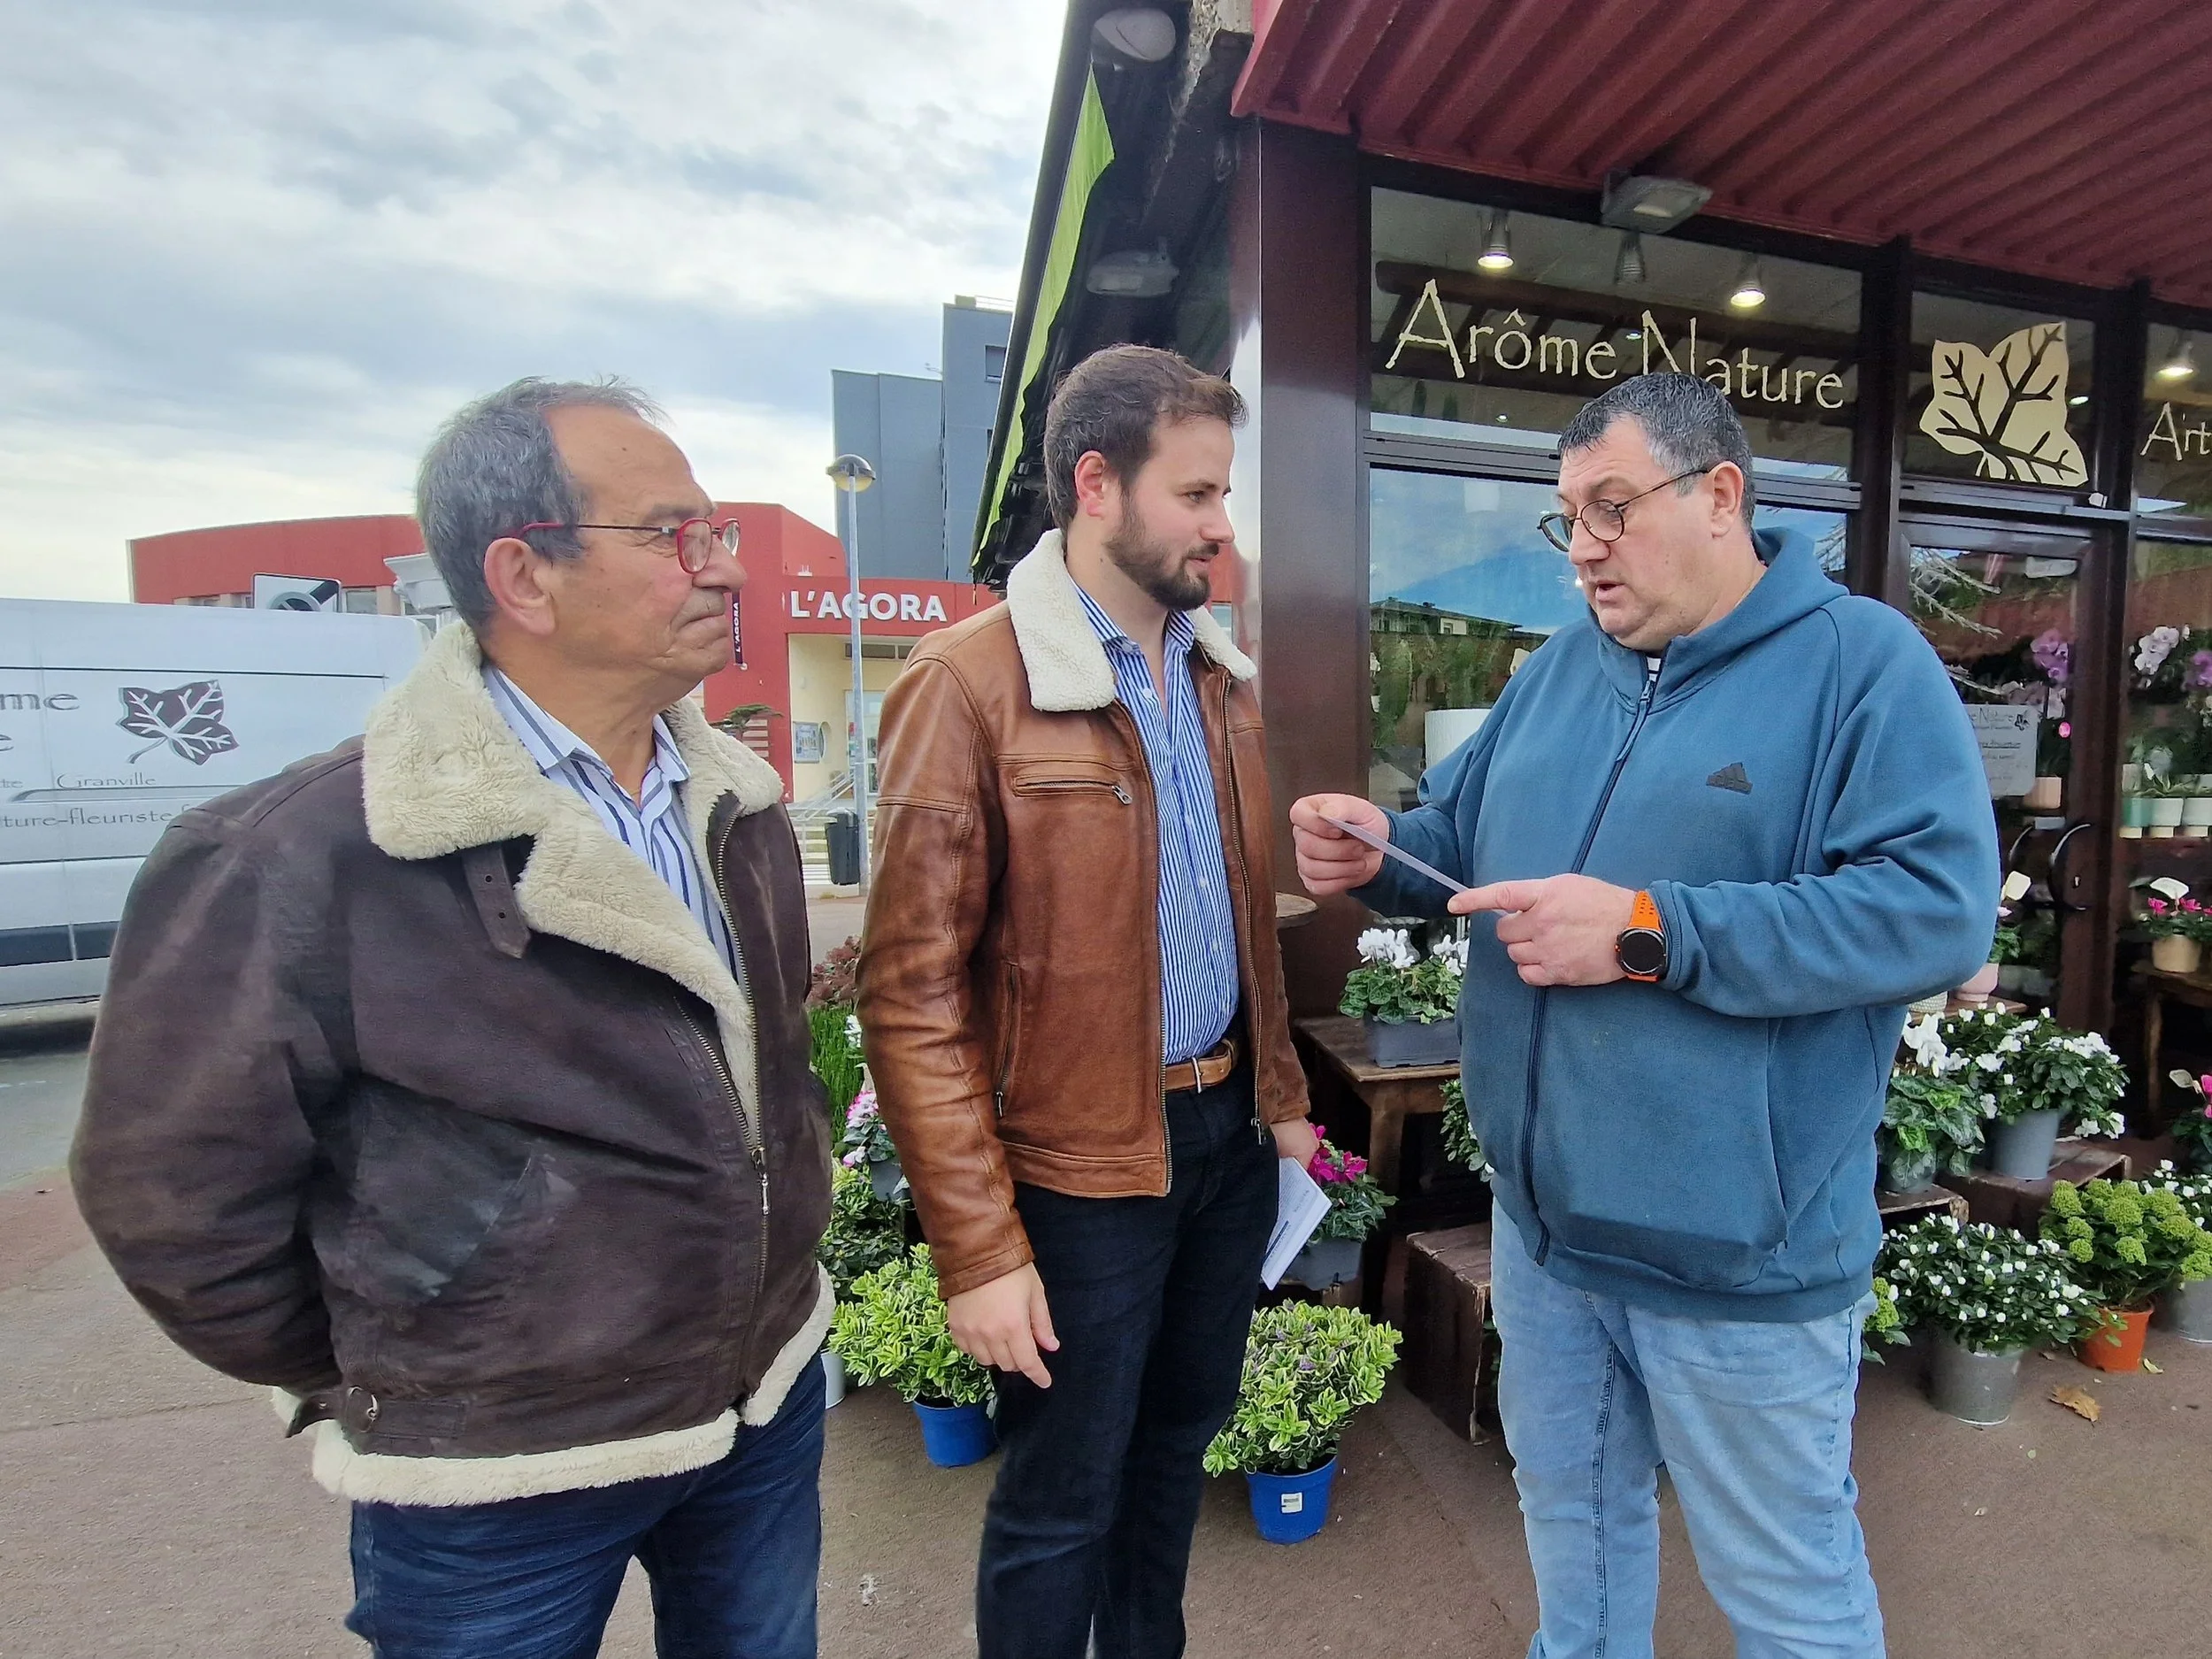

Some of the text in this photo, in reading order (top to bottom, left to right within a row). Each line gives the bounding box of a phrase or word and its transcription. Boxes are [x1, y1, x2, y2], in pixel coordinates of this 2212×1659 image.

[1385, 278, 1845, 409] Arôme Nature
[2139, 402, 2212, 461] Art
[733, 602, 741, 653] L'AGORA
[790, 590, 948, 622] L'AGORA
[57, 772, 157, 789] Granville
